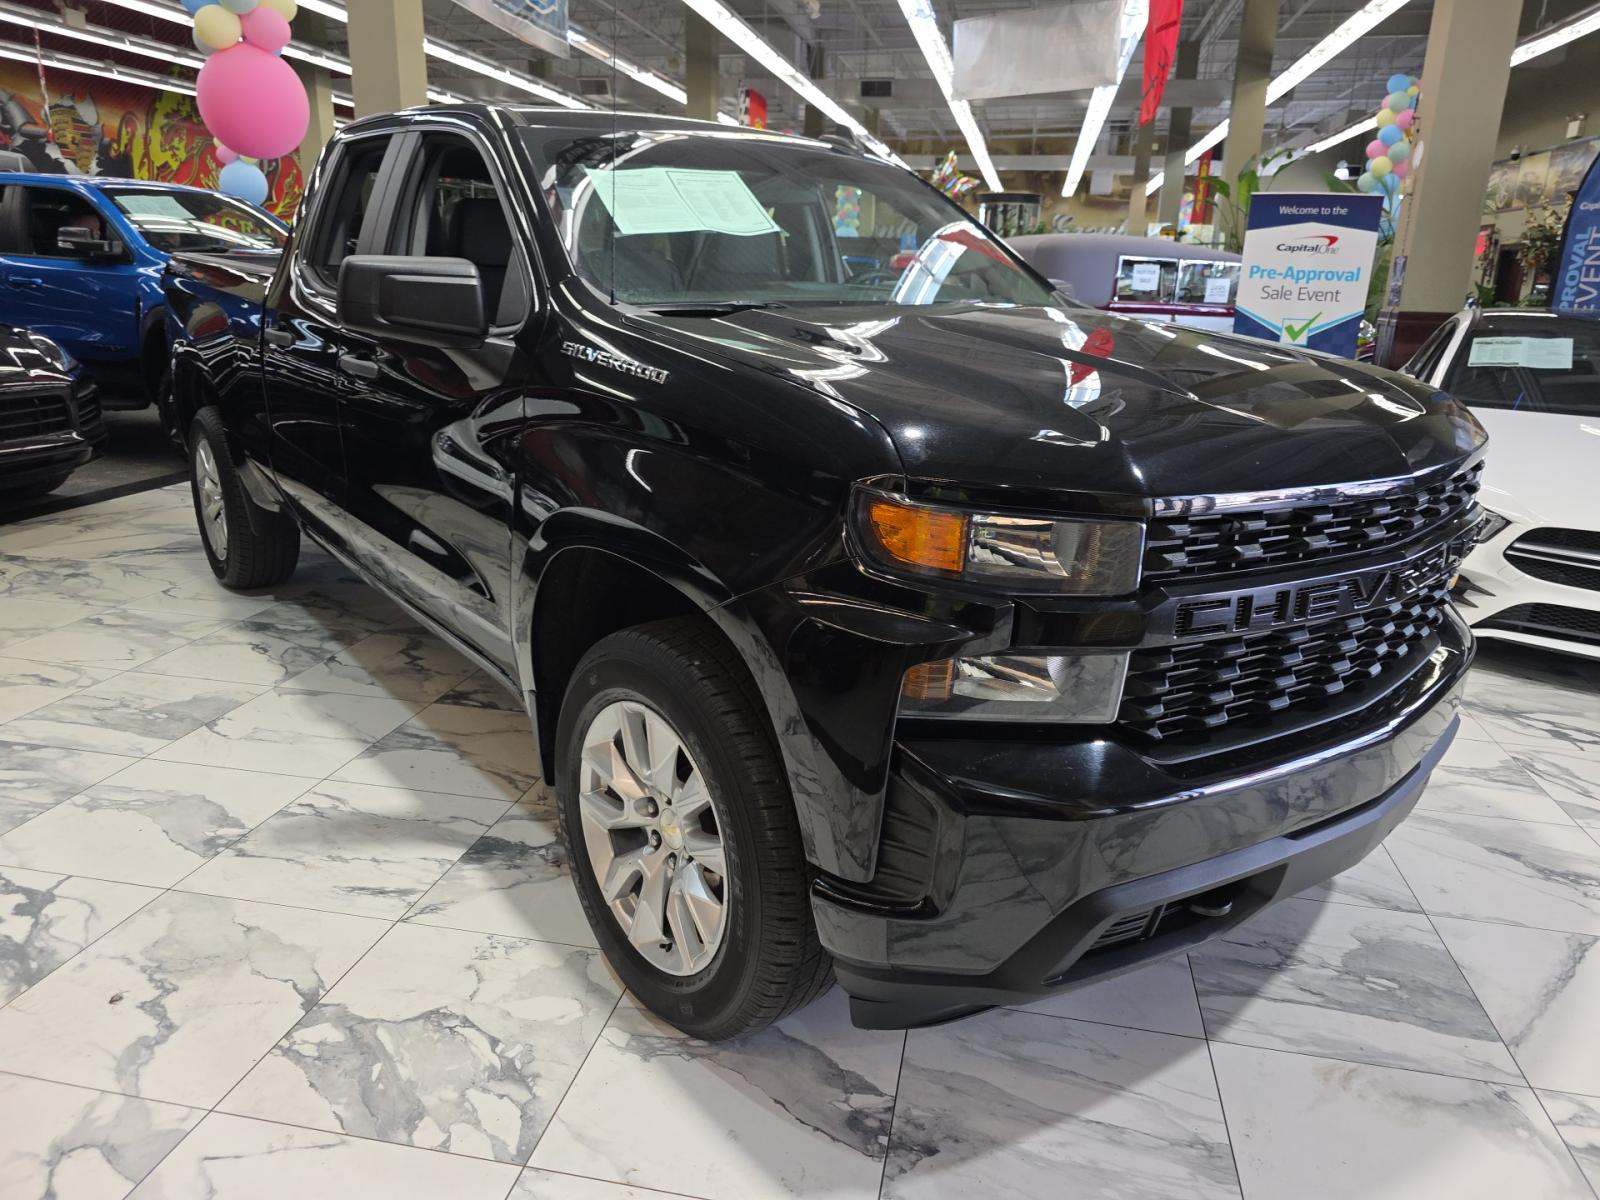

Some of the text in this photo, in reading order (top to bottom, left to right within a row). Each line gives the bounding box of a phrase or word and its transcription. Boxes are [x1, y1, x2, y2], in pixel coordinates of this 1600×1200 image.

[1279, 205, 1349, 215] Welcome to the
[1249, 265, 1362, 284] Pre-Approval
[1260, 285, 1342, 303] Sale Event
[559, 340, 671, 385] SILVERADO
